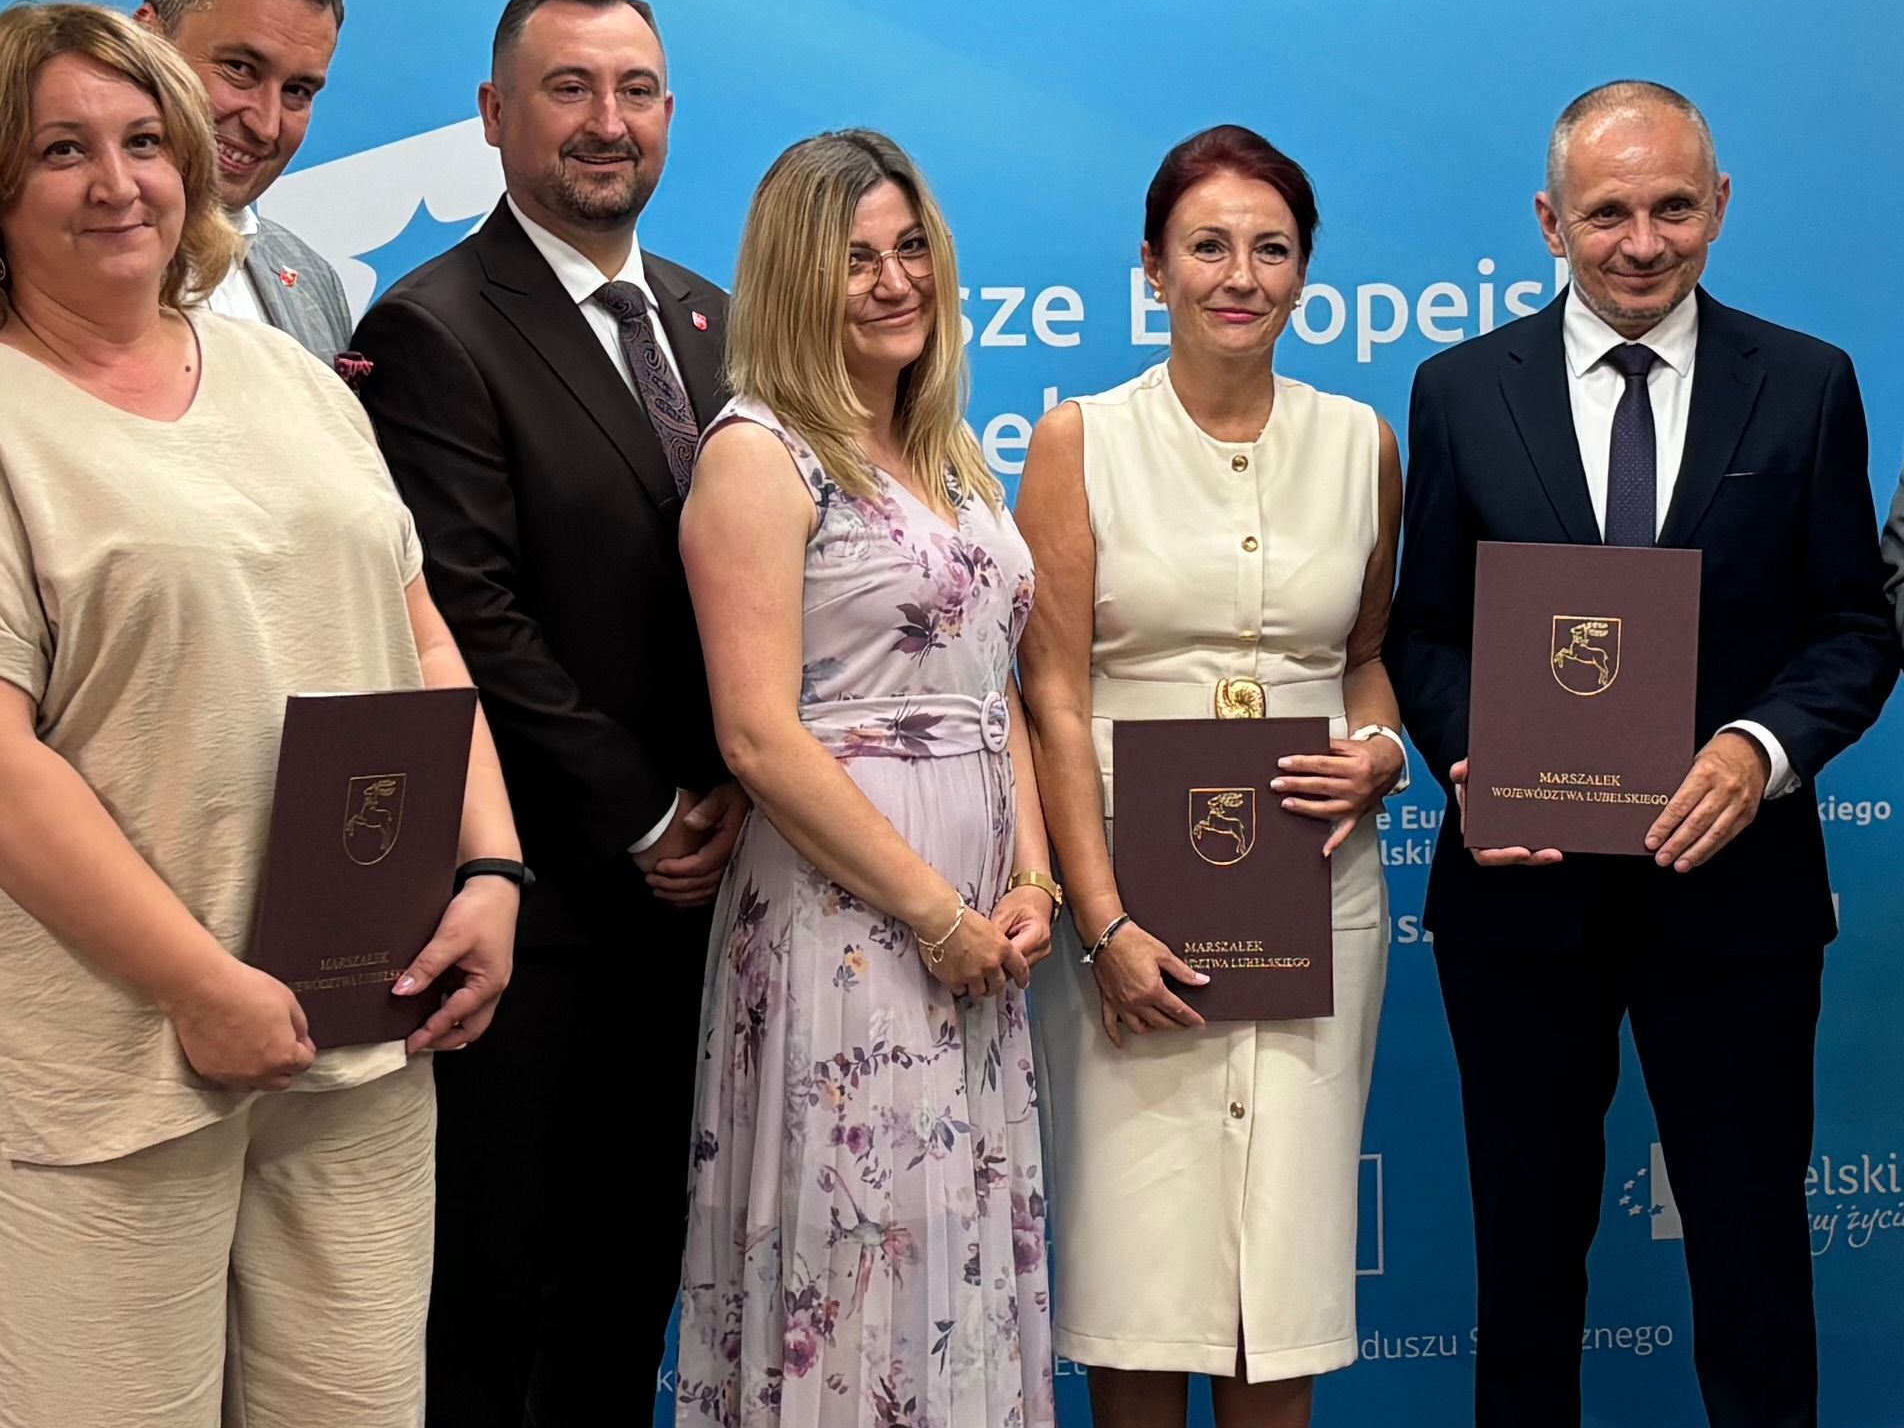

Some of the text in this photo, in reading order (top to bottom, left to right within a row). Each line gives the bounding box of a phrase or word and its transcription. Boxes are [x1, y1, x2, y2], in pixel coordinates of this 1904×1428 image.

[1539, 772, 1621, 787] MARSZAŁEK
[1491, 786, 1669, 806] WOJEWÓDZTWA LUBELSKIEGO
[1360, 1330, 1458, 1360] duszu
